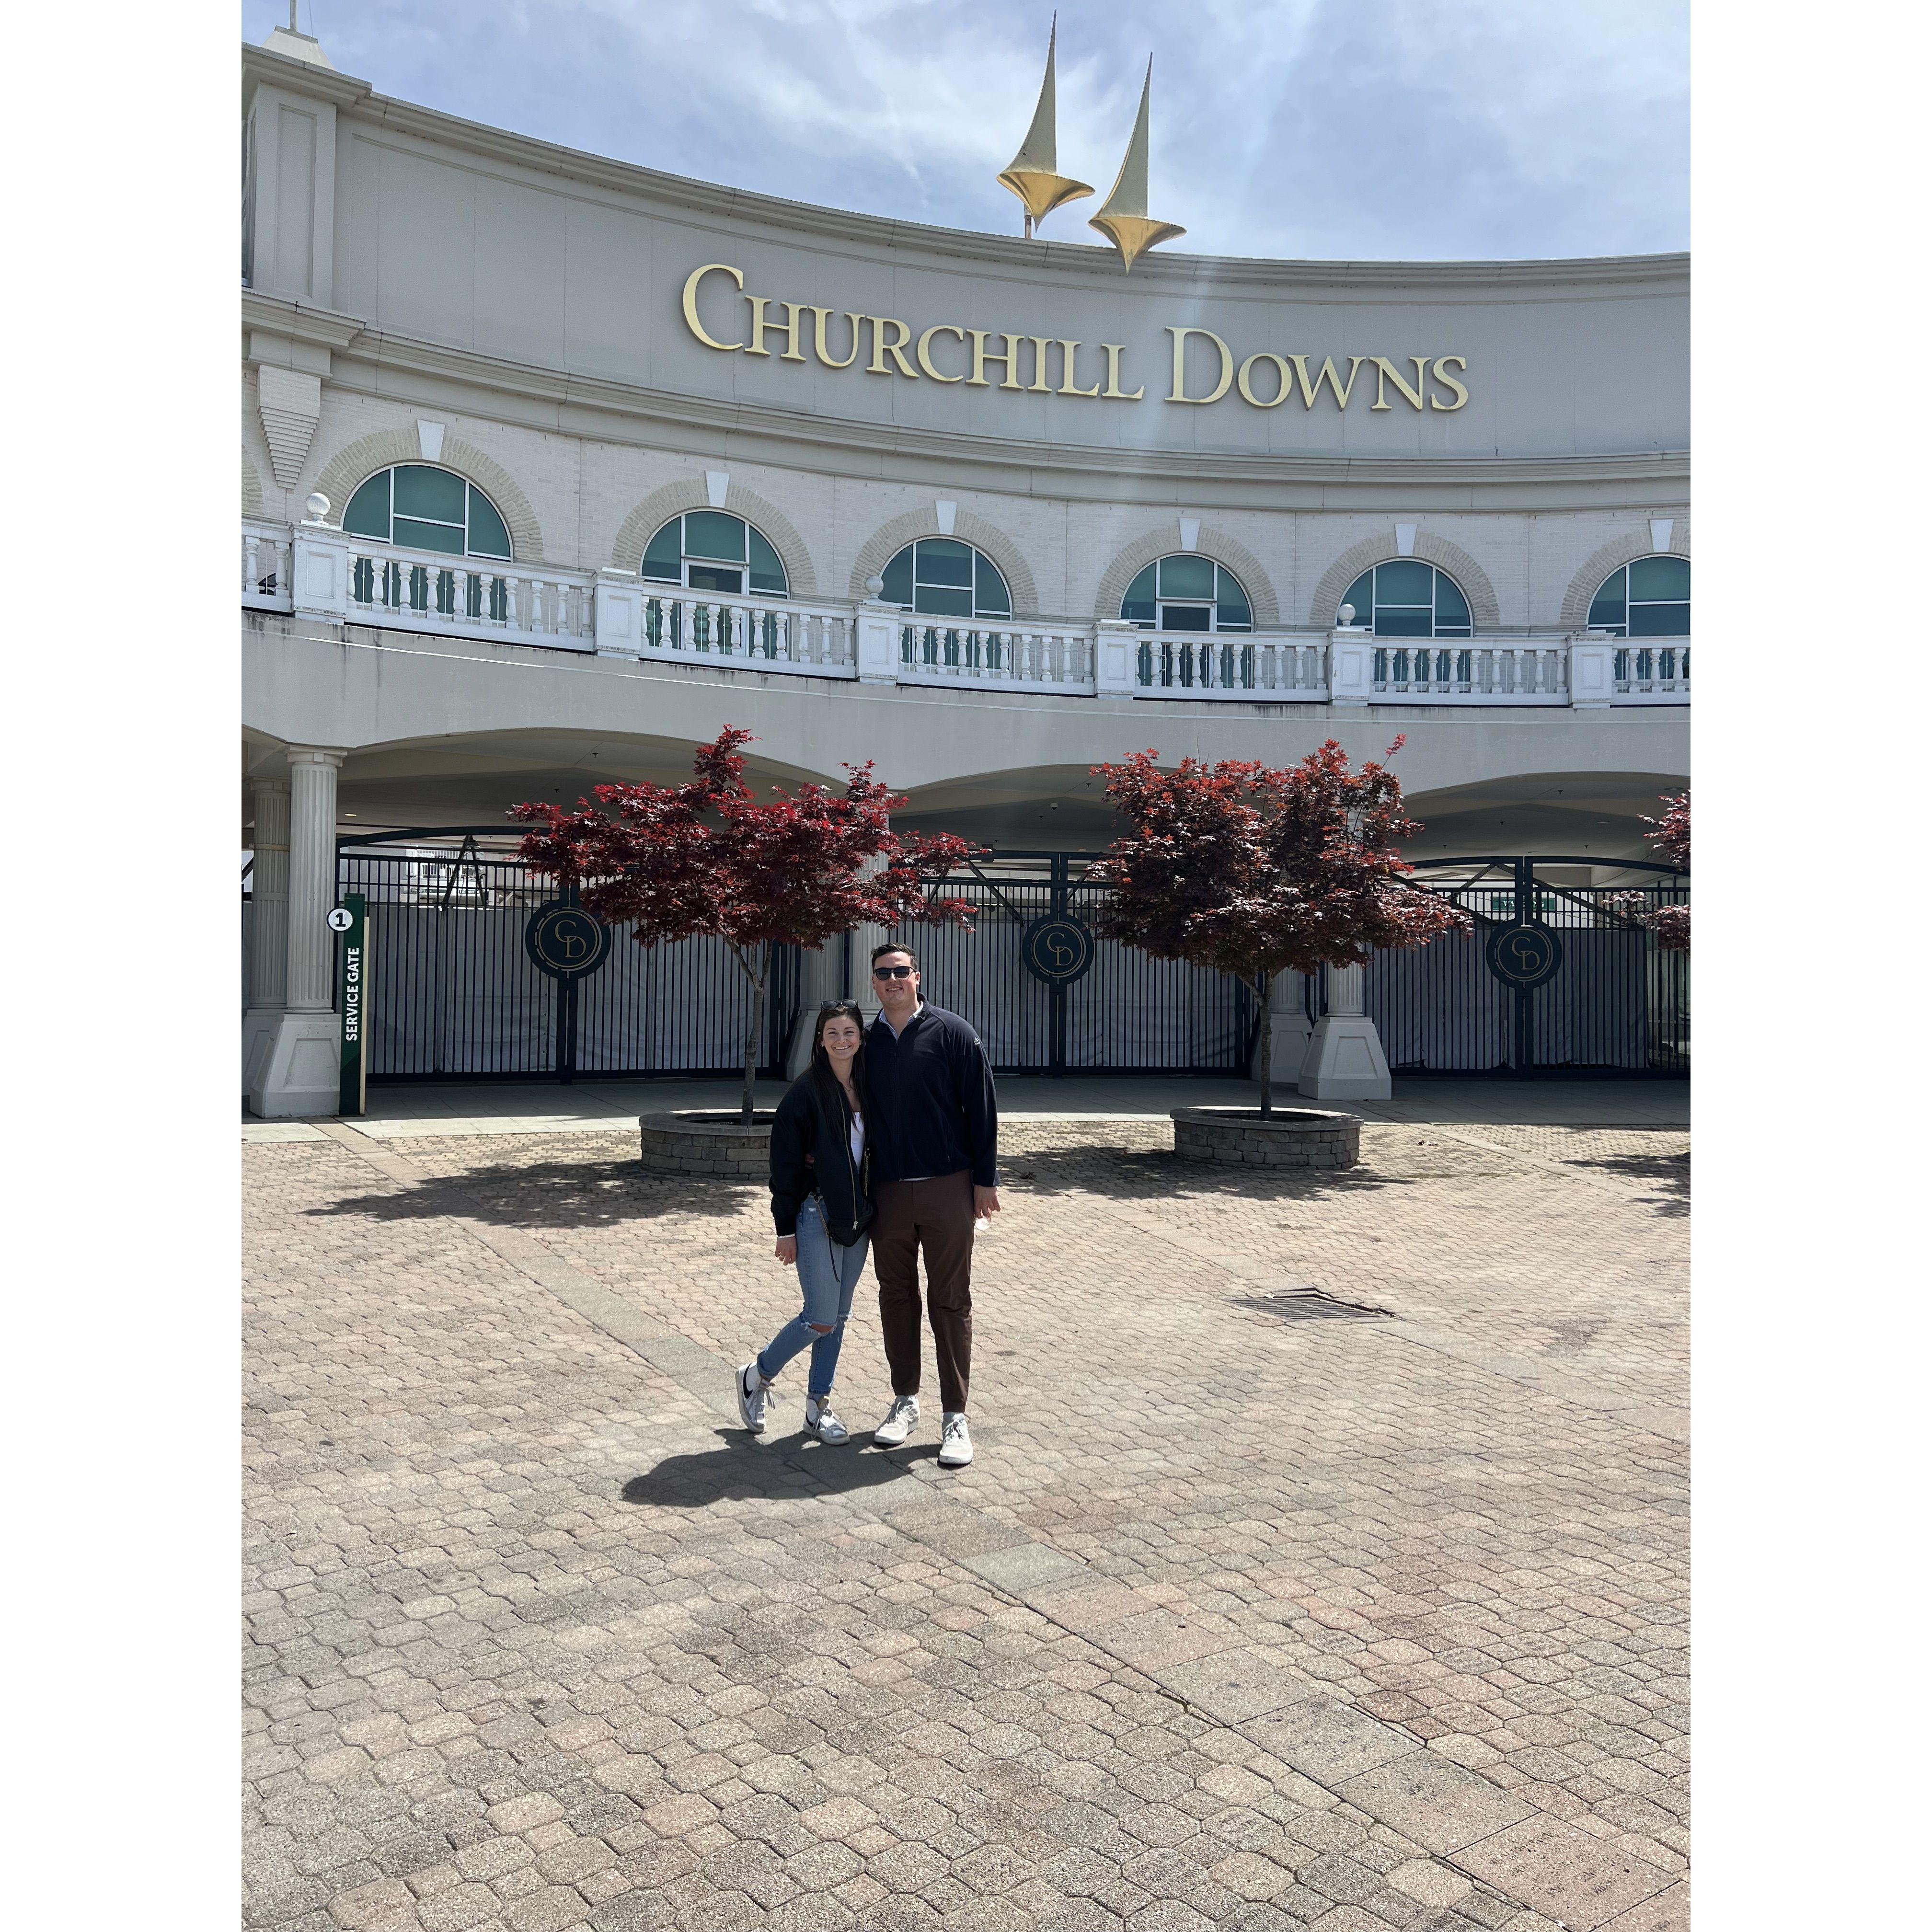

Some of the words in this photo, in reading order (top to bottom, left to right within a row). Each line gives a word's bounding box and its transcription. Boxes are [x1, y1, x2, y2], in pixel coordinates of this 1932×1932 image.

[682, 264, 1145, 401] CHURCHILL
[1164, 326, 1469, 413] DOWNS
[335, 912, 346, 927] 1
[347, 947, 359, 982] GATE
[345, 985, 358, 1041] SERVICE
